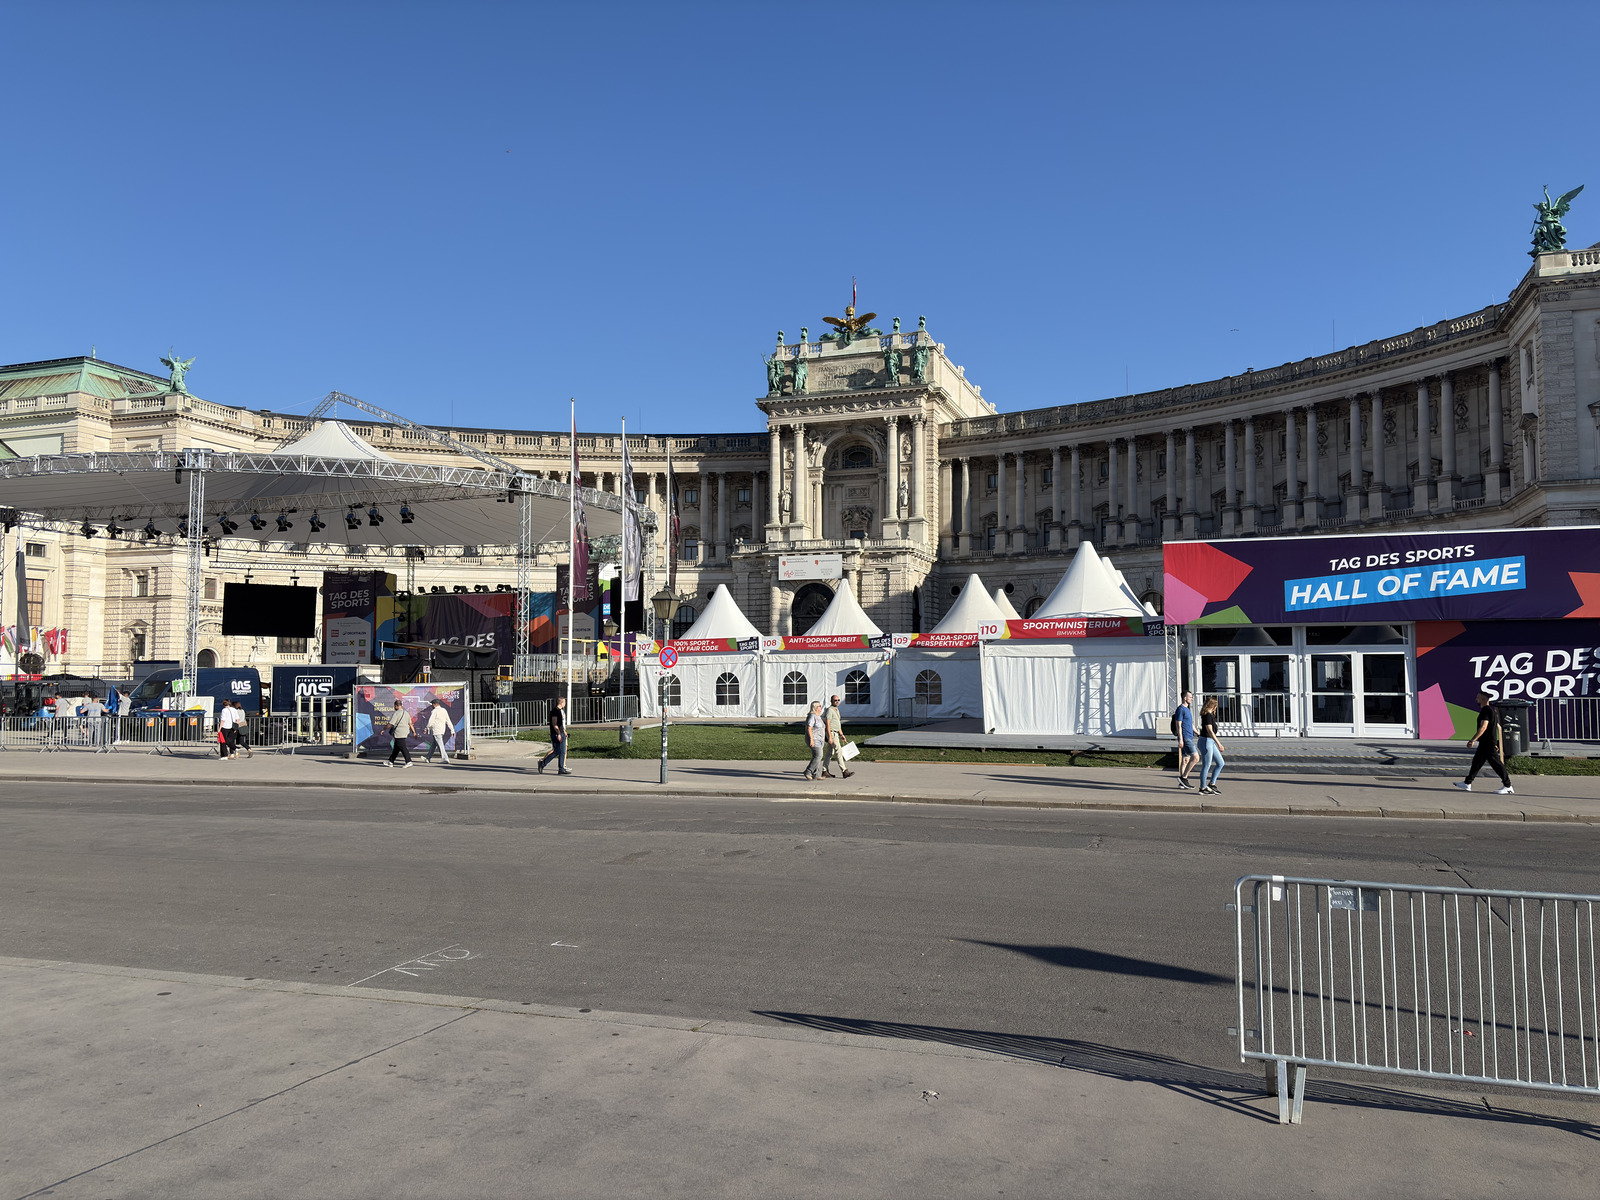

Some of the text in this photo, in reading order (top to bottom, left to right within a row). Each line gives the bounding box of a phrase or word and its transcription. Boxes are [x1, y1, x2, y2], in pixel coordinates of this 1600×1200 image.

[1329, 544, 1475, 571] TAG DES SPORTS
[1290, 563, 1521, 606] HALL OF FAME
[328, 589, 369, 601] TAG DES
[331, 597, 370, 609] SPORTS
[980, 624, 998, 636] 110
[1023, 620, 1121, 630] SPORTMINISTERIUM
[465, 632, 495, 648] DES
[763, 639, 777, 648] 108
[894, 637, 908, 645] 109
[639, 643, 651, 651] 107
[1469, 652, 1534, 678] TAG
[231, 680, 251, 690] MS
[296, 682, 333, 696] MS
